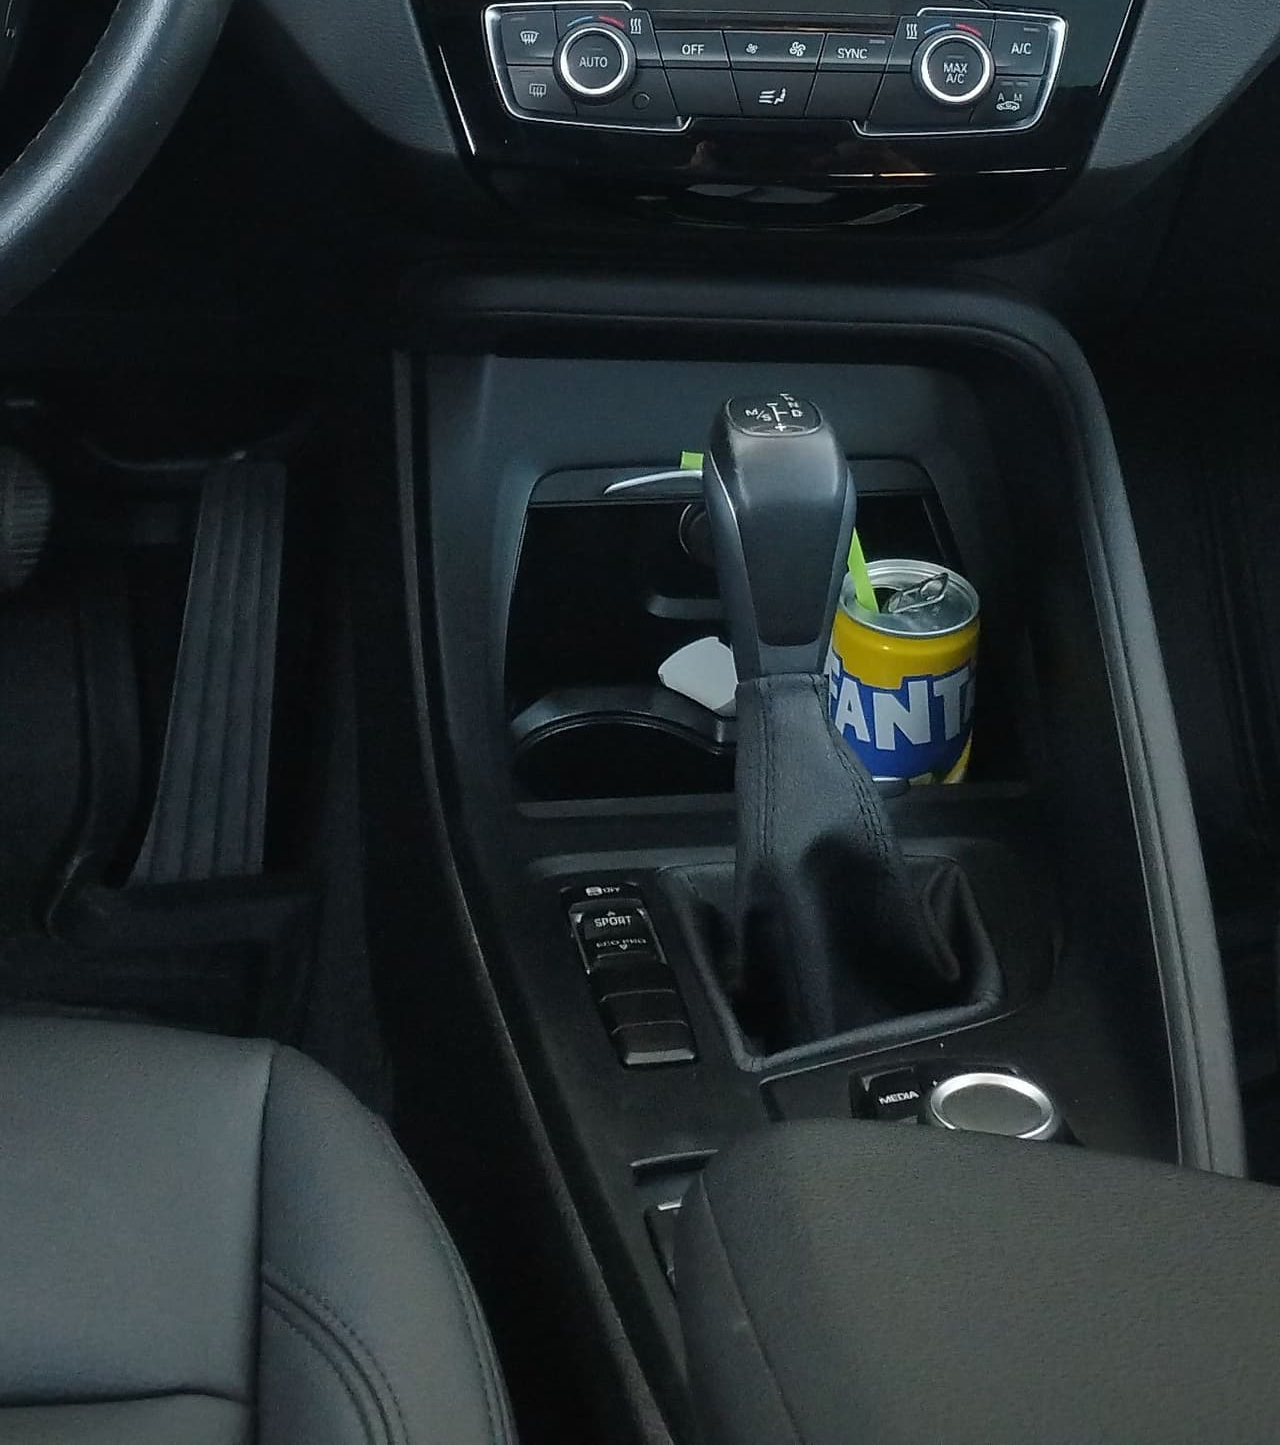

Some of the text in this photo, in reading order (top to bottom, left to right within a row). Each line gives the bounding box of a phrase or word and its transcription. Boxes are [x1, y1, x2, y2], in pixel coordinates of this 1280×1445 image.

[681, 43, 705, 55] OFF
[837, 48, 868, 60] SYNC
[1011, 42, 1032, 55] A/C
[578, 56, 608, 68] AUTO
[943, 62, 968, 74] MAX
[945, 73, 965, 84] A/C
[823, 648, 978, 751] FANT
[593, 915, 632, 928] SPORT
[878, 1090, 920, 1105] MEDIA
